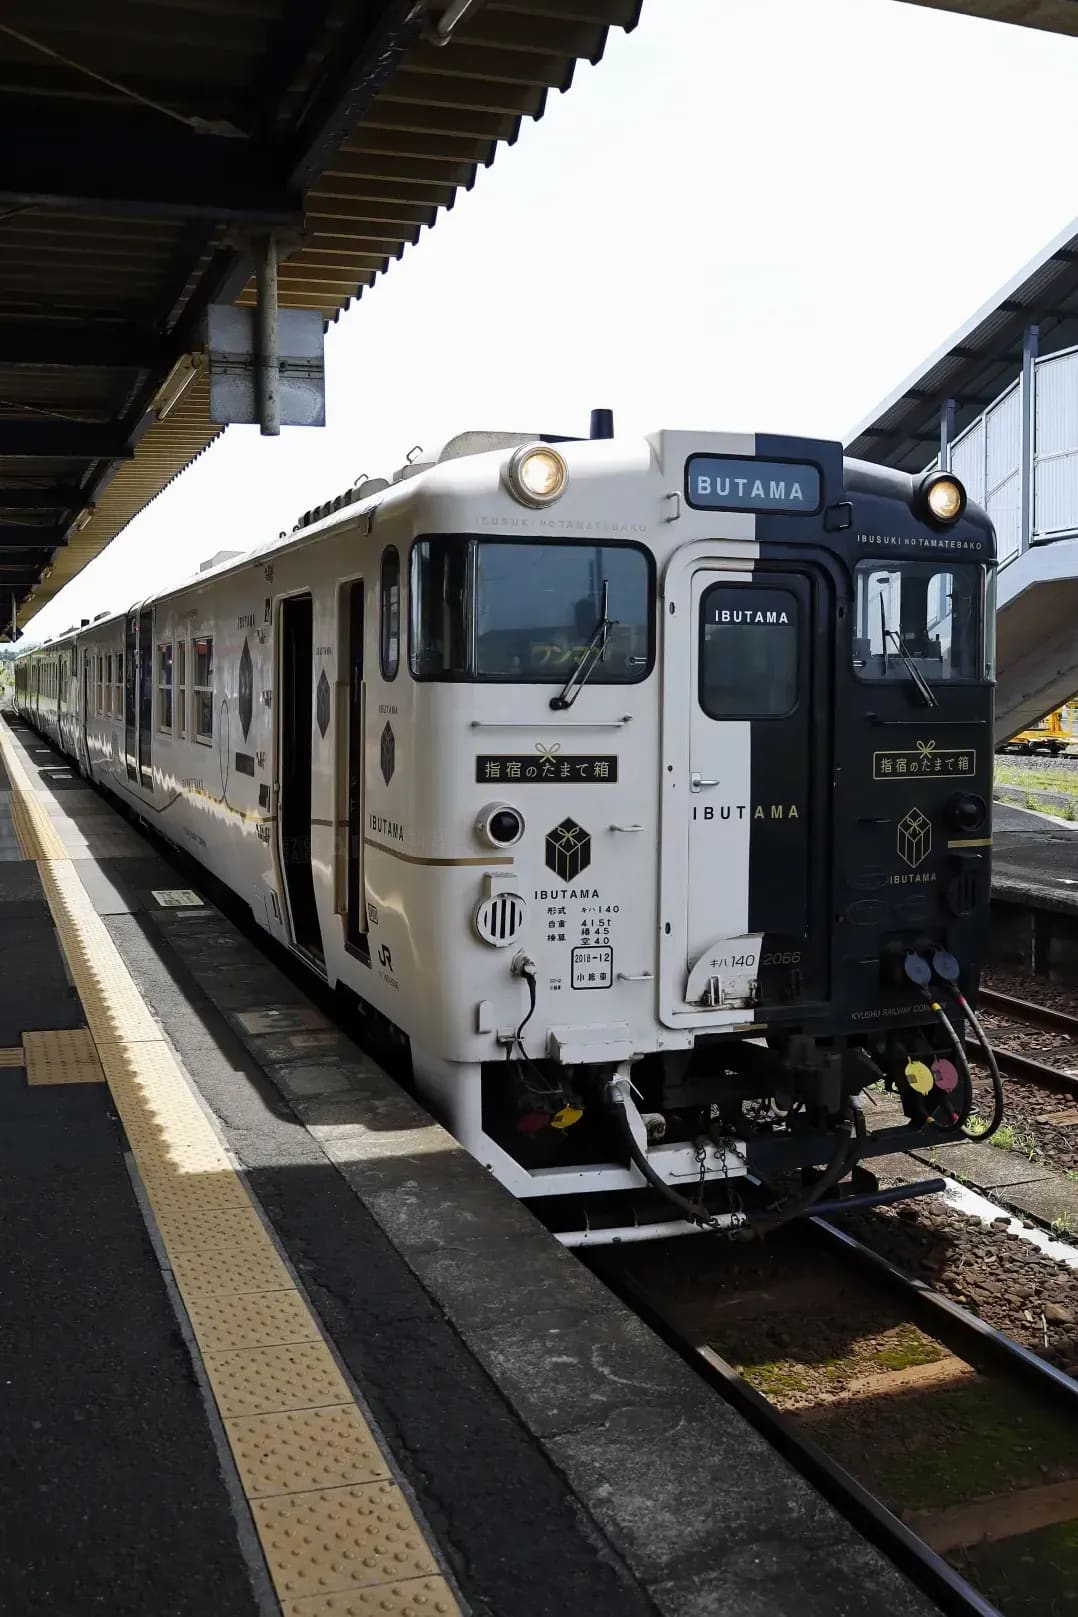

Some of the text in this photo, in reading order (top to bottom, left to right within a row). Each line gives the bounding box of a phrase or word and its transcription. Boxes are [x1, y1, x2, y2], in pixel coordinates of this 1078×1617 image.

[857, 534, 901, 545] IBUSUKI
[918, 538, 982, 550] TAMATEBAKO
[715, 609, 789, 624] IBUTAMA
[484, 760, 611, 778] 指宿のたまて箱
[880, 756, 969, 773] 指宿のたまて箱
[693, 804, 799, 820] IBUTAMA
[369, 813, 405, 842] IBUTAMA
[890, 872, 937, 885] IBUTAMA
[534, 889, 600, 900] IBUTAMA
[378, 943, 394, 973] JR
[851, 1008, 881, 1021] KYUSHU
[882, 1006, 911, 1017] RAILWAY
